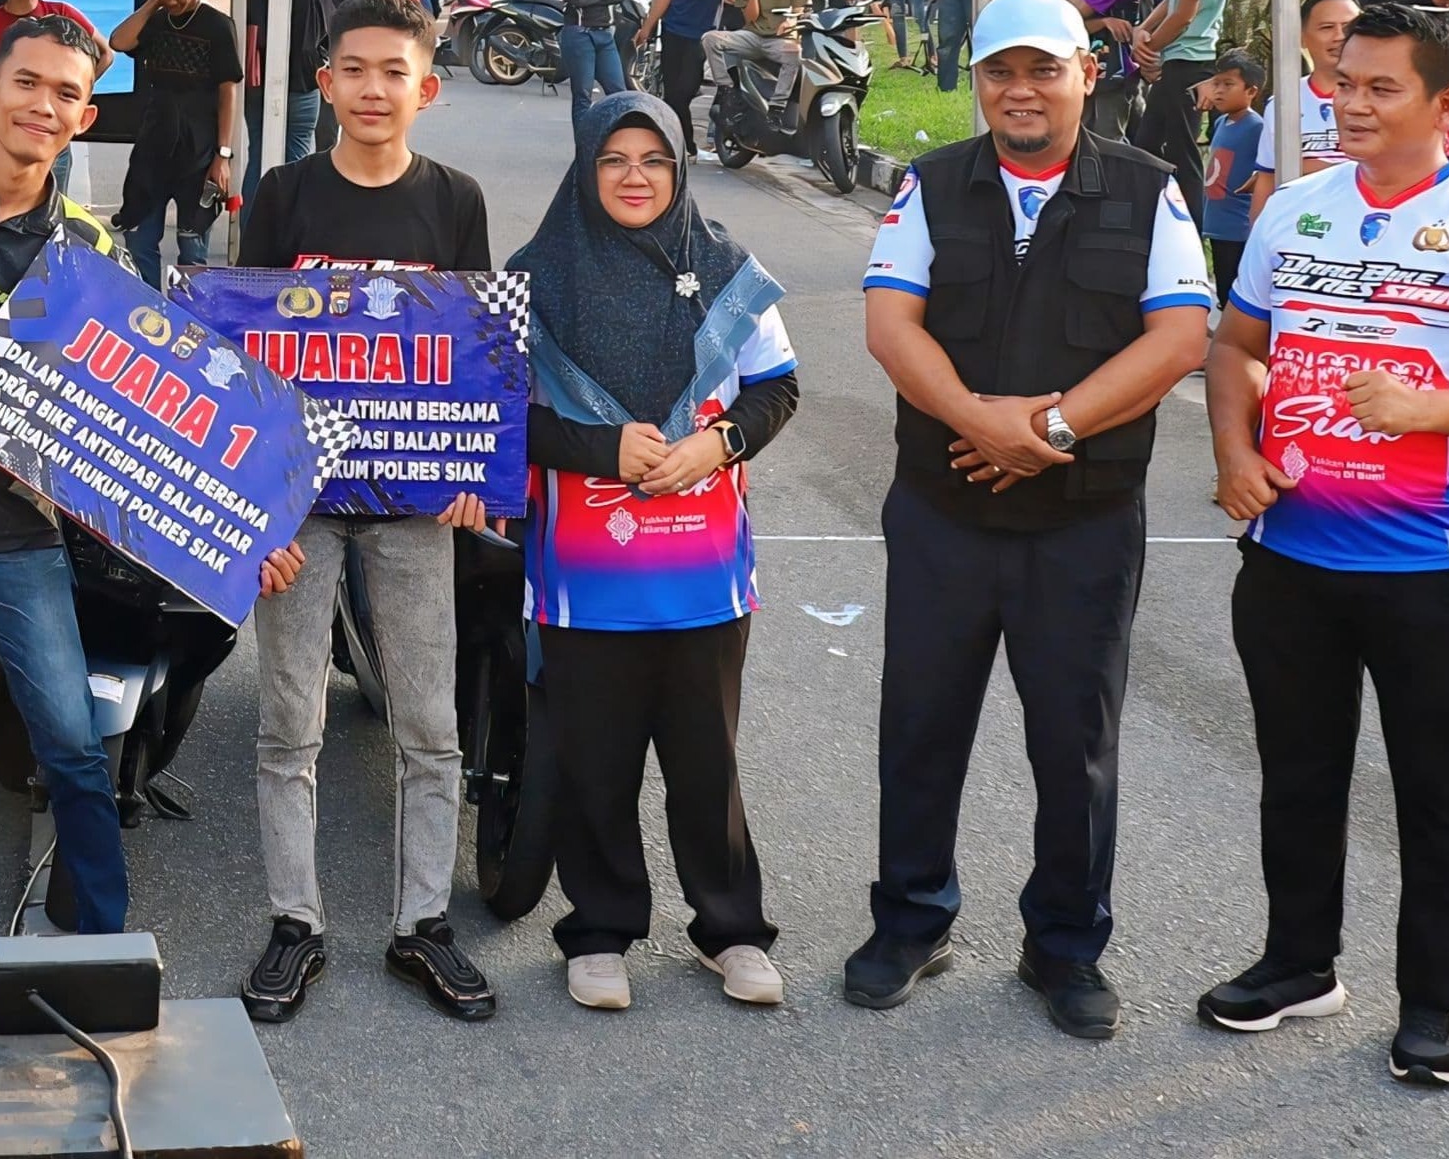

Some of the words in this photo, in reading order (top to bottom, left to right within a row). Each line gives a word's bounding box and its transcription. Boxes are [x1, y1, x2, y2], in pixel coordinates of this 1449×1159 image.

[61, 317, 220, 448] JUARA
[219, 423, 258, 472] 1
[244, 330, 407, 384] JUARA
[412, 333, 453, 385] II
[4, 342, 61, 391] DALAM
[60, 373, 129, 437] RANGKA
[125, 416, 195, 478] LATIHAN
[193, 460, 271, 534] BERSAMA
[337, 399, 412, 421] LATIHAN
[417, 402, 501, 423] BERSAMA
[393, 431, 452, 452] BALAP
[455, 432, 497, 453] LIAR
[35, 398, 78, 436] BIKE
[72, 426, 161, 494] ANTISIPASI
[159, 473, 215, 527] BALAP
[212, 509, 254, 556] LIAR
[69, 455, 131, 507] HUKUM
[126, 496, 190, 548] POLRES
[187, 534, 231, 575] SIAK
[373, 461, 441, 481] POLRES
[444, 462, 486, 482] SIAK
